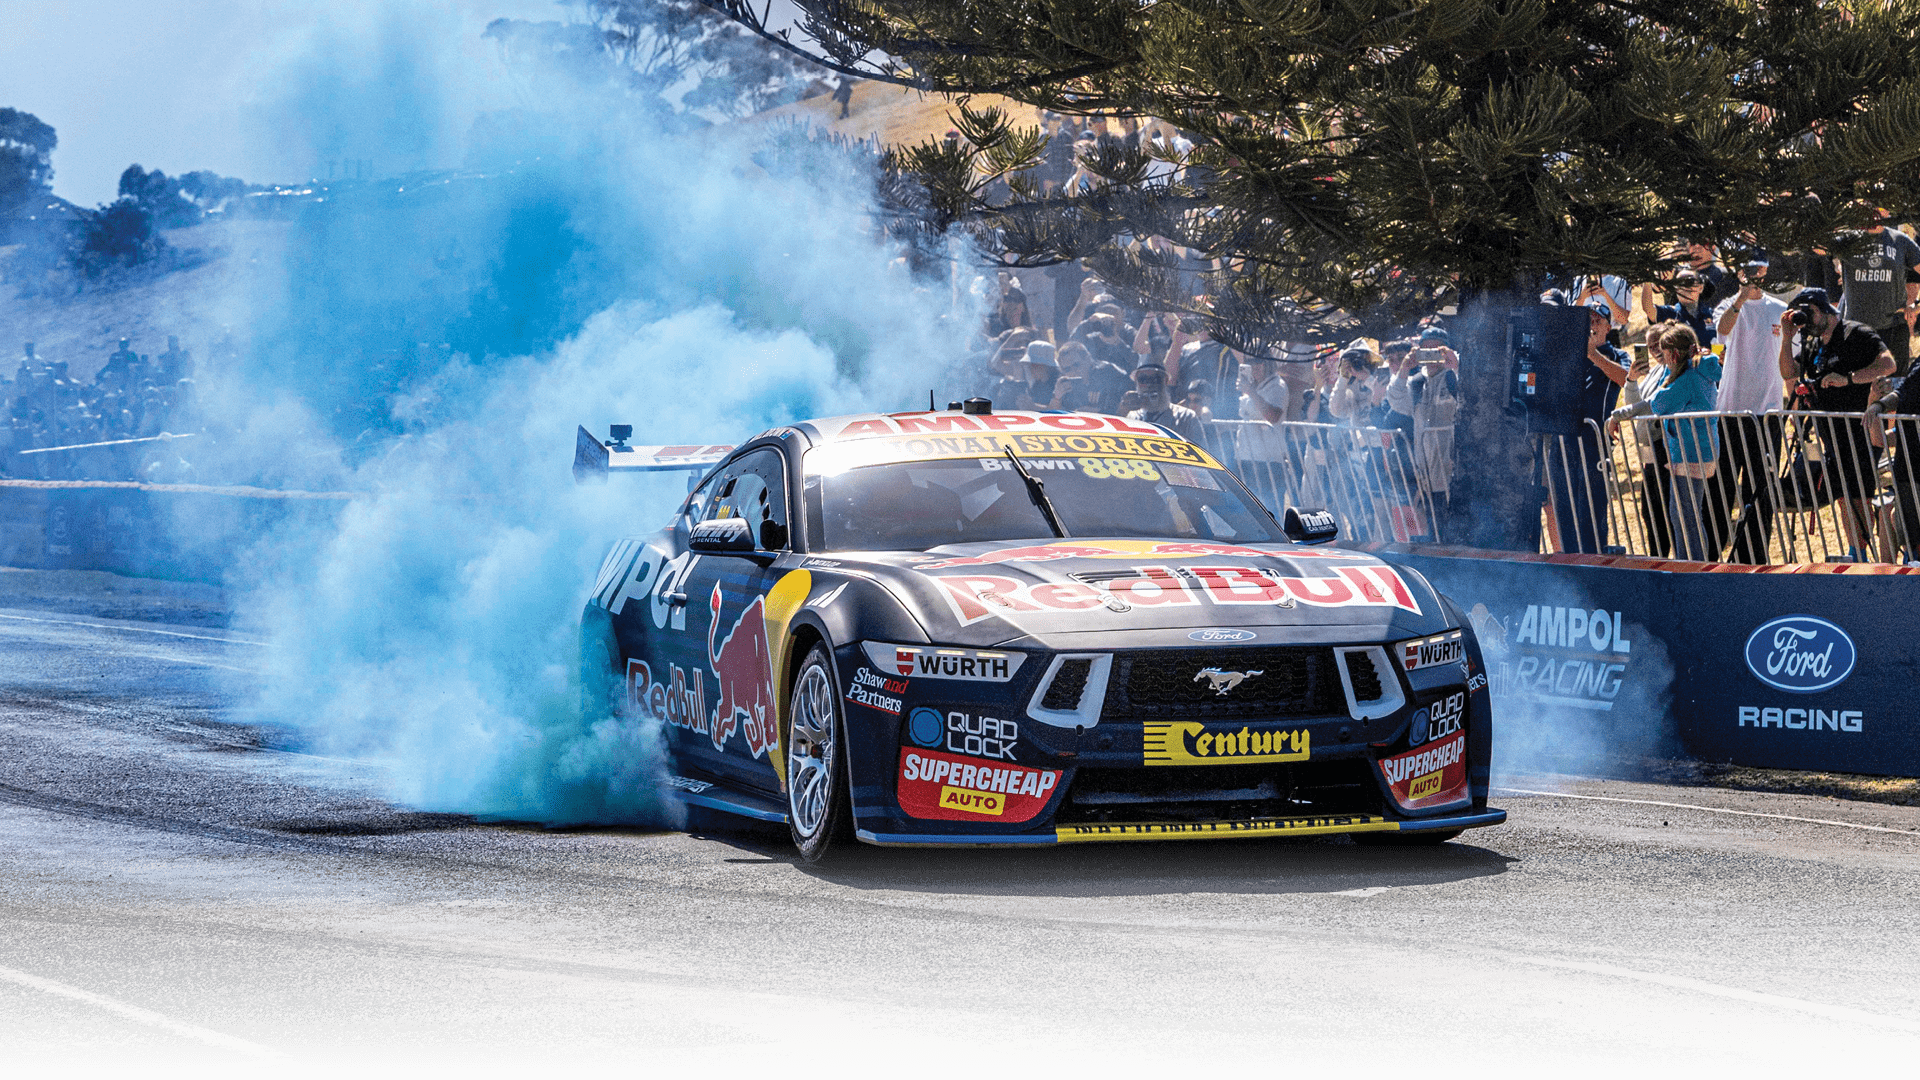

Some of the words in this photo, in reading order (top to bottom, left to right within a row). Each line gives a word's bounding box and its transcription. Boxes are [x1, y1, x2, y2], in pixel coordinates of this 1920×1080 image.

[1854, 269, 1892, 282] OREGON
[837, 414, 1159, 437] AMPOL
[900, 436, 1005, 456] ONAL
[1020, 435, 1199, 461] STORAGE
[978, 458, 1075, 471] Brown
[1078, 457, 1161, 481] 888
[591, 538, 702, 631] MPOL
[1202, 629, 1243, 641] Ford
[1516, 604, 1631, 653] AMPOL
[918, 655, 1009, 678] WÜRTH
[1420, 638, 1462, 666] WÜRTH
[1766, 626, 1834, 679] Ford
[1514, 656, 1626, 699] RACING
[845, 683, 902, 714] Partners
[1430, 691, 1464, 721] QUAD
[947, 711, 1018, 741] QUAD
[1429, 711, 1463, 742] LOCK
[1738, 705, 1863, 732] RACING
[947, 731, 1018, 761] LOCK
[1143, 721, 1310, 766] Century
[904, 753, 1057, 798] SUPERCHEAP
[1384, 735, 1465, 786] SUPERCHEAP
[945, 791, 998, 810] AUTO
[1412, 776, 1440, 797] AUTO
